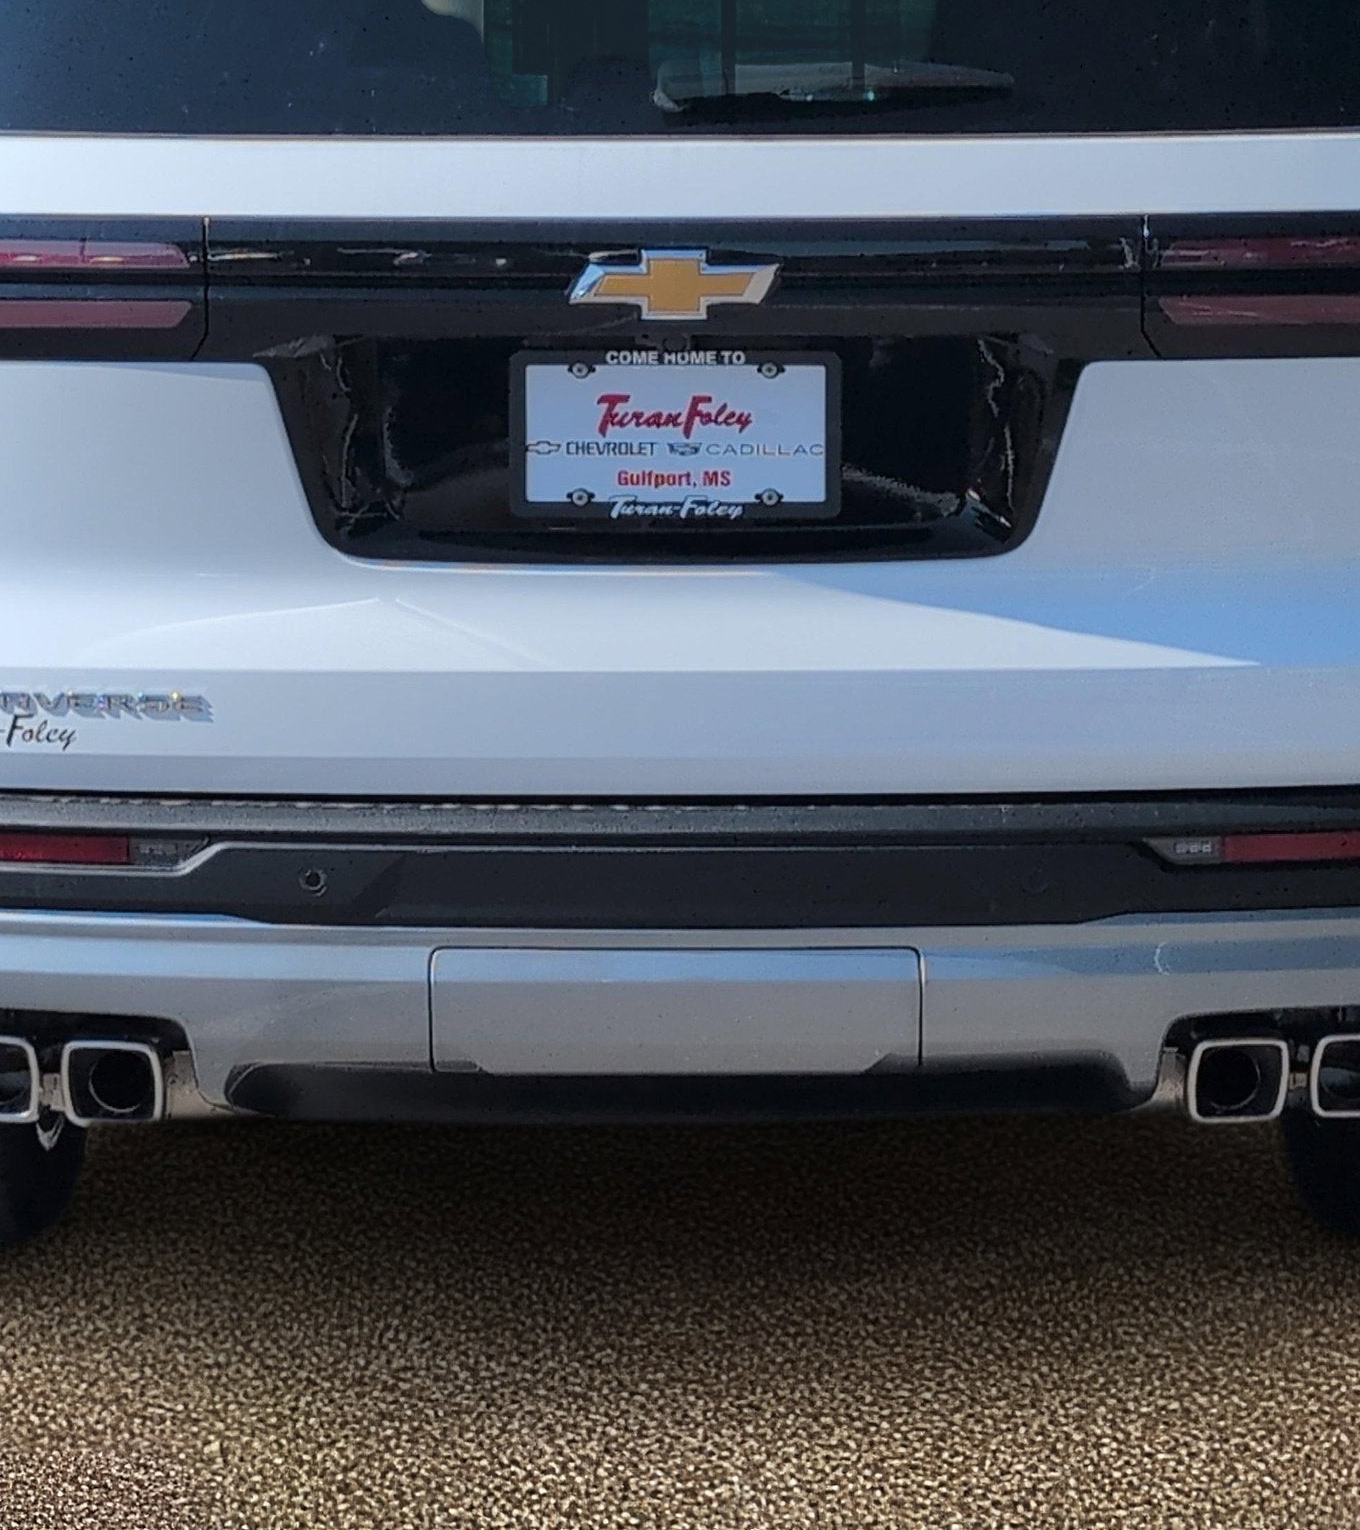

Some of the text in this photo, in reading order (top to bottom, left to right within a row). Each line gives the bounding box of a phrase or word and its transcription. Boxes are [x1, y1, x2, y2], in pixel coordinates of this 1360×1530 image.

[605, 350, 746, 365] COME HOME TO
[565, 441, 824, 456] CHEVROLET CADILLAC
[617, 469, 731, 488] Gulfport, MS
